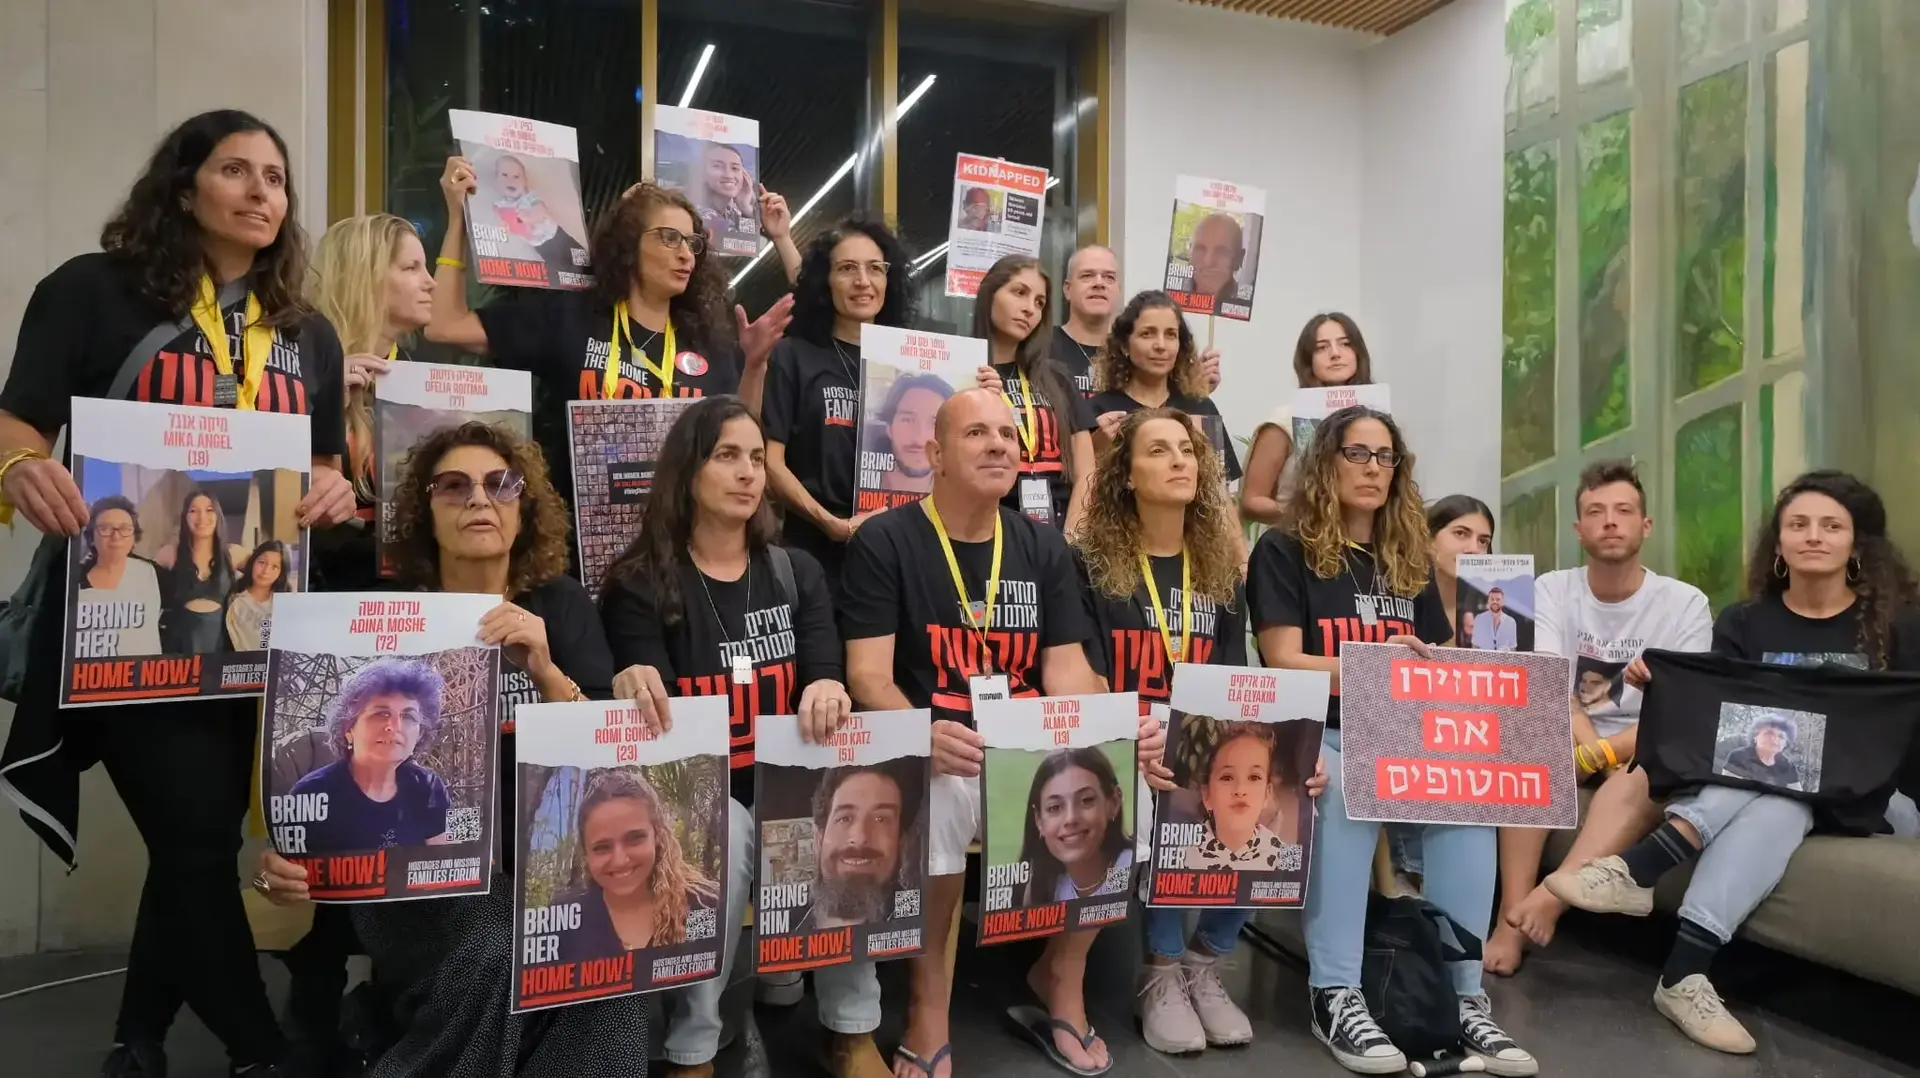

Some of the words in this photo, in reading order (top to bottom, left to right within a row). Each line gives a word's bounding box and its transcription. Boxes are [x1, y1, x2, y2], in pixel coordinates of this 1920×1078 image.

[963, 162, 1040, 187] KIDNAPPED
[472, 223, 507, 242] BRING
[476, 240, 500, 257] HIM
[479, 259, 512, 276] HOME
[515, 261, 548, 279] NOW!
[1168, 262, 1194, 278] BRING
[1166, 275, 1183, 290] HIM
[1190, 294, 1215, 309] NOW!
[586, 337, 621, 361] BRI
[919, 348, 937, 359] SHEM
[618, 361, 648, 386] HOME
[920, 359, 931, 371] (21)
[426, 381, 450, 392] OFELIA
[453, 382, 487, 395] ROITMAN
[823, 386, 860, 402] HOSTAG
[825, 399, 858, 420] FAMI
[168, 412, 195, 430] אנגל
[200, 416, 227, 432] מיקה
[164, 430, 193, 447] MIKA
[198, 433, 232, 449] ANGEL
[188, 449, 208, 467] (18)
[861, 451, 894, 471] BRING
[859, 470, 881, 489] HIM
[859, 492, 889, 509] HOME
[77, 602, 144, 630] BRING
[358, 601, 384, 616] משה
[388, 601, 420, 615] עדינה
[1005, 604, 1038, 628] אותם
[350, 619, 383, 633] ADINA
[387, 618, 426, 632] MOSHE
[75, 631, 118, 658] HER
[376, 634, 398, 652] (72)
[73, 663, 133, 690] HOME
[141, 655, 203, 686] NOW!
[222, 672, 260, 685] FAMILIES
[1231, 674, 1259, 688] אליקים
[1260, 675, 1276, 688] אלה
[1400, 667, 1520, 700] החזירו
[1228, 689, 1242, 701] ELA
[1244, 690, 1276, 703] ELYAKIM
[1042, 701, 1055, 714] אור
[1058, 700, 1080, 713] עלמה
[1241, 703, 1260, 718] (8.5)
[605, 709, 623, 727] גונן
[1043, 716, 1066, 729] ALMA
[1068, 715, 1080, 728] OR
[595, 728, 621, 744] ROMI
[850, 731, 871, 745] KATZ
[1055, 730, 1070, 745] (13)
[1433, 716, 1489, 746] את
[617, 744, 637, 763] (23)
[839, 748, 854, 763] (51)
[1386, 763, 1541, 800] החטופים
[271, 792, 328, 824] BRING
[273, 825, 307, 854] HER
[1161, 823, 1202, 846] BRING
[329, 849, 386, 886] NOW!
[408, 861, 440, 871] HOSTAGES
[440, 859, 453, 869] AND
[453, 857, 480, 867] MISSING
[1159, 847, 1186, 869] HER
[408, 869, 447, 885] FAMILIES
[448, 867, 480, 882] FORUM
[987, 860, 1030, 888] BRING
[1156, 873, 1196, 895] HOME
[1199, 871, 1239, 895] NOW!
[760, 883, 808, 910] BRING
[986, 888, 1013, 911] HER
[524, 903, 581, 935] BRING
[759, 911, 790, 935] HIM
[983, 909, 1023, 936] HOME
[1026, 900, 1067, 932] NOW!
[523, 935, 559, 965] HER
[759, 936, 803, 962] HOME
[808, 926, 851, 958] NOW!
[681, 954, 692, 963] AND
[521, 962, 574, 996] HOME
[580, 951, 633, 987] NOW!
[653, 963, 687, 979] FAMILIES
[688, 959, 717, 974] FORUM
